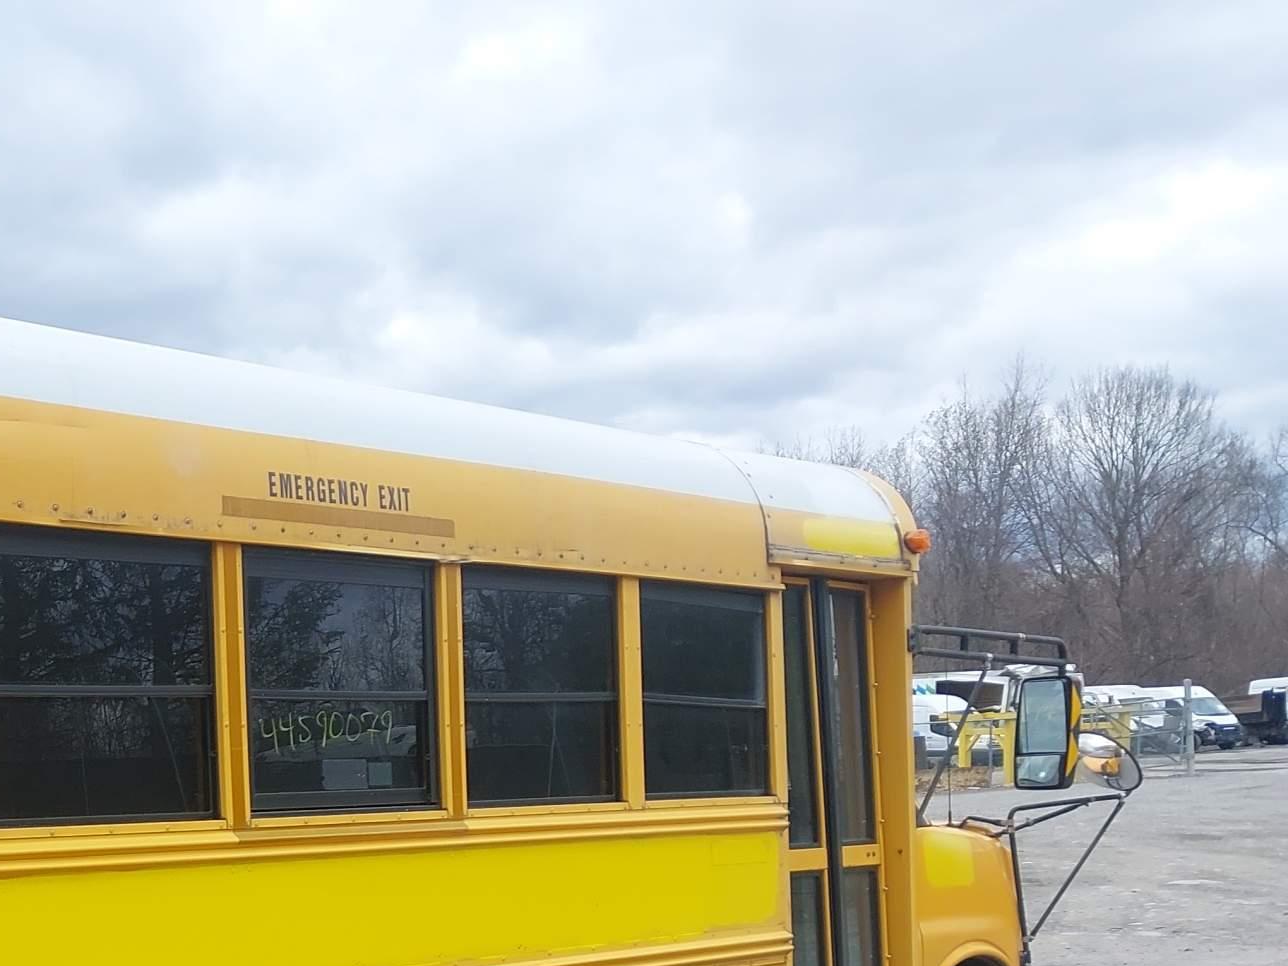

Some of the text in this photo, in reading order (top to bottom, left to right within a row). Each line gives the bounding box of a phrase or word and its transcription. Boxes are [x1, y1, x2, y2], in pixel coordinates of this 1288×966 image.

[268, 471, 410, 512] EMERGENCY EXIT
[259, 710, 393, 755] 44590079
